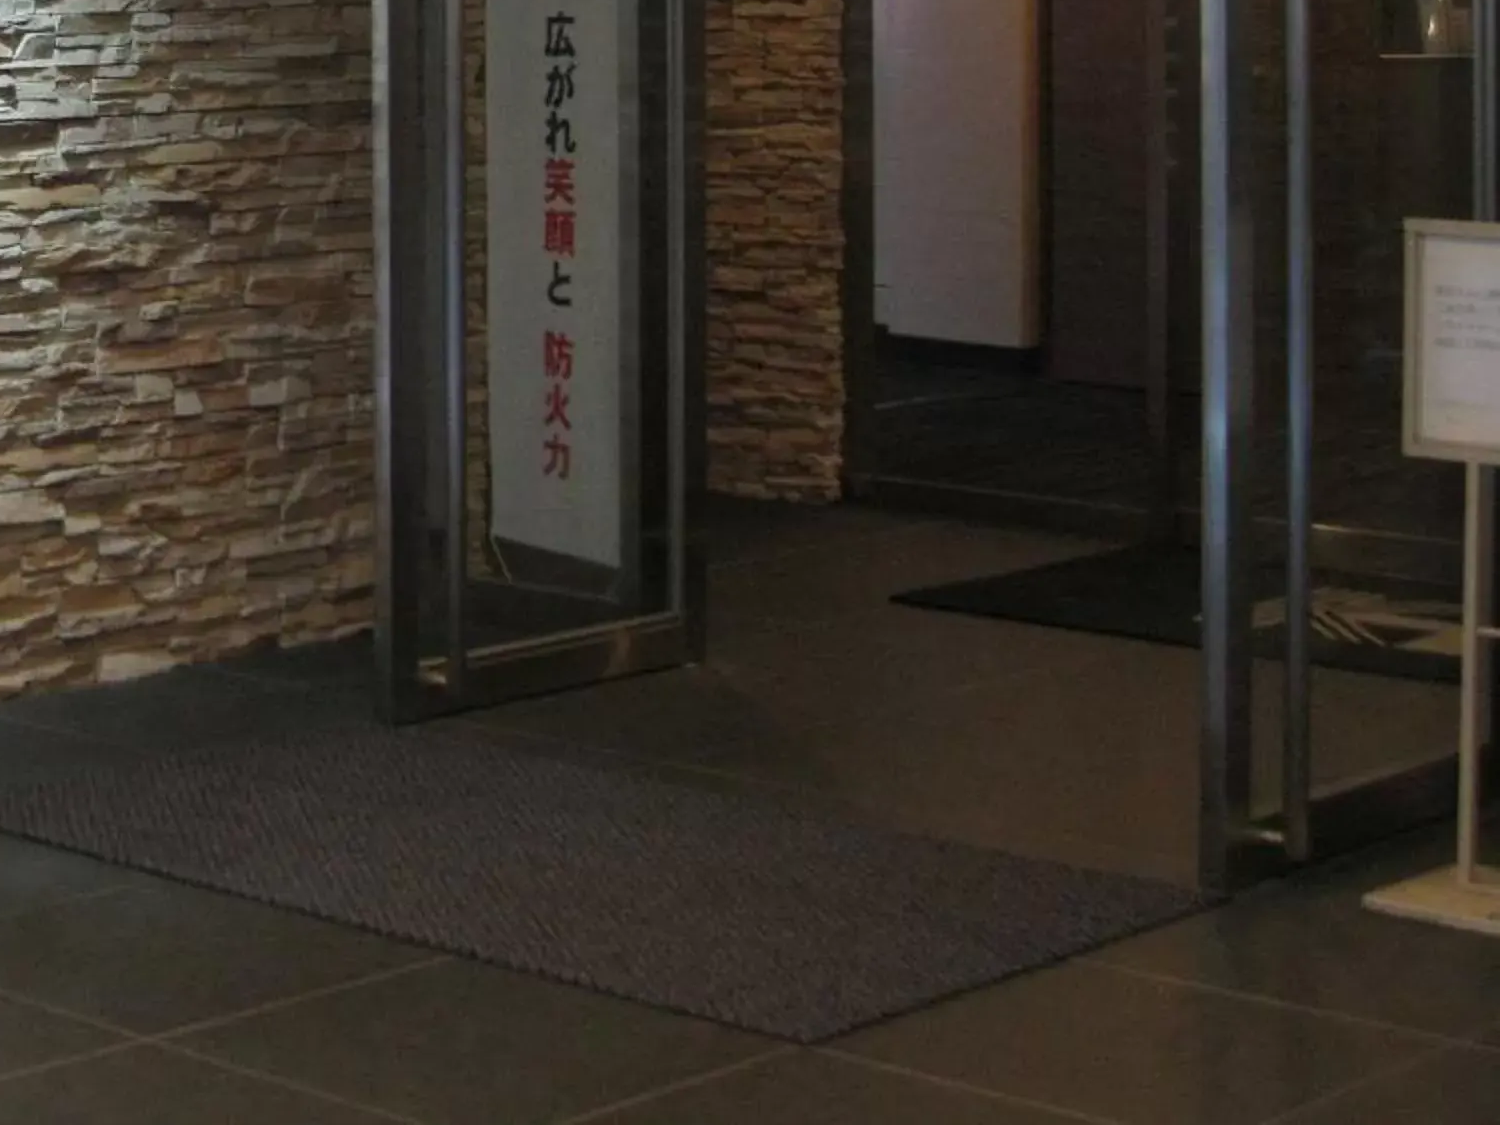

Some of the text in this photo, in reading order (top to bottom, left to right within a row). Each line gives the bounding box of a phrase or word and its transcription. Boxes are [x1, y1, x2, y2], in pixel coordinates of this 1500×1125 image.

[543, 10, 578, 308] 広がれ笑顔と
[542, 330, 576, 480] 防火力
